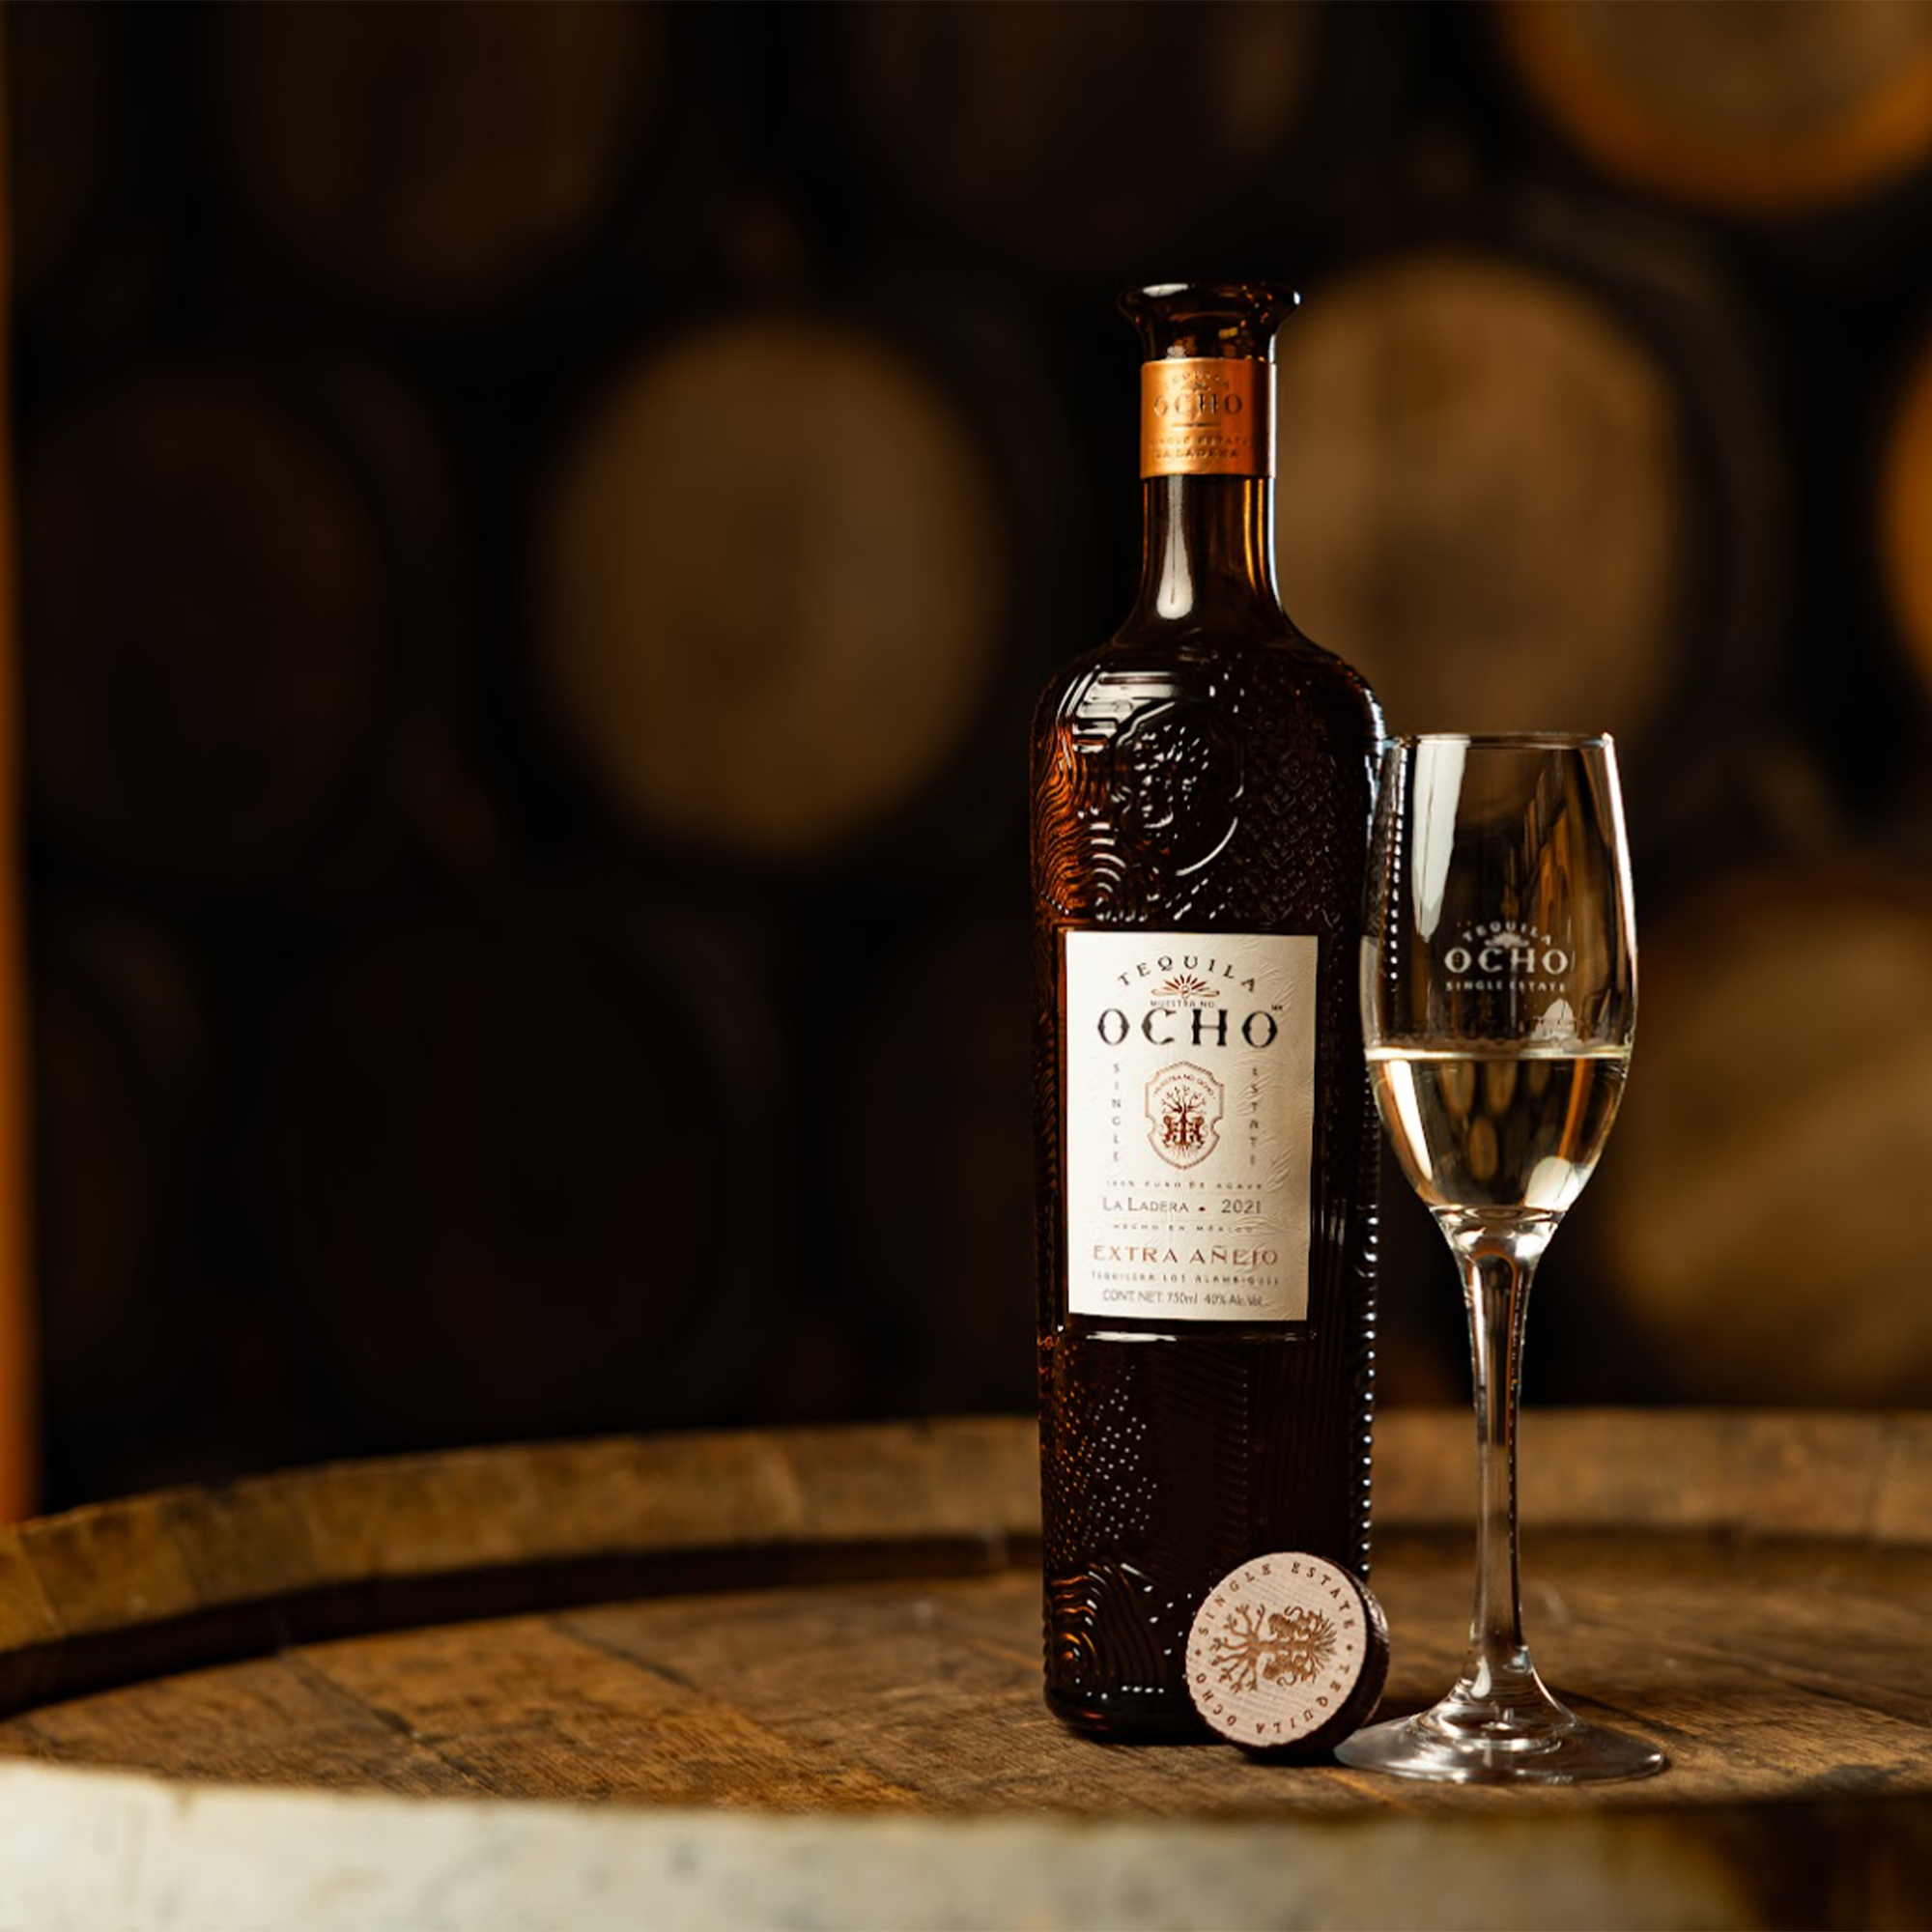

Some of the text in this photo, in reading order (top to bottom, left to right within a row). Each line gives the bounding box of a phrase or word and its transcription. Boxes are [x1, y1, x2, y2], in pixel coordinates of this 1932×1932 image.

[1153, 393, 1242, 417] OCHO
[1463, 921, 1551, 946] TEQUILA
[1117, 954, 1256, 993] TEQUILA
[1444, 947, 1568, 975] OCHO
[1445, 980, 1566, 993] SINGLE ESTATE
[1150, 999, 1196, 1008] MUESTRA
[1097, 1008, 1278, 1049] OCHO
[1221, 1199, 1261, 1214] 2021
[1094, 1244, 1279, 1266] EXTRA AÑEJO
[1199, 1561, 1355, 1635] SINGLE ESTATE
[1196, 1663, 1350, 1734] TEQUILA OCHO
